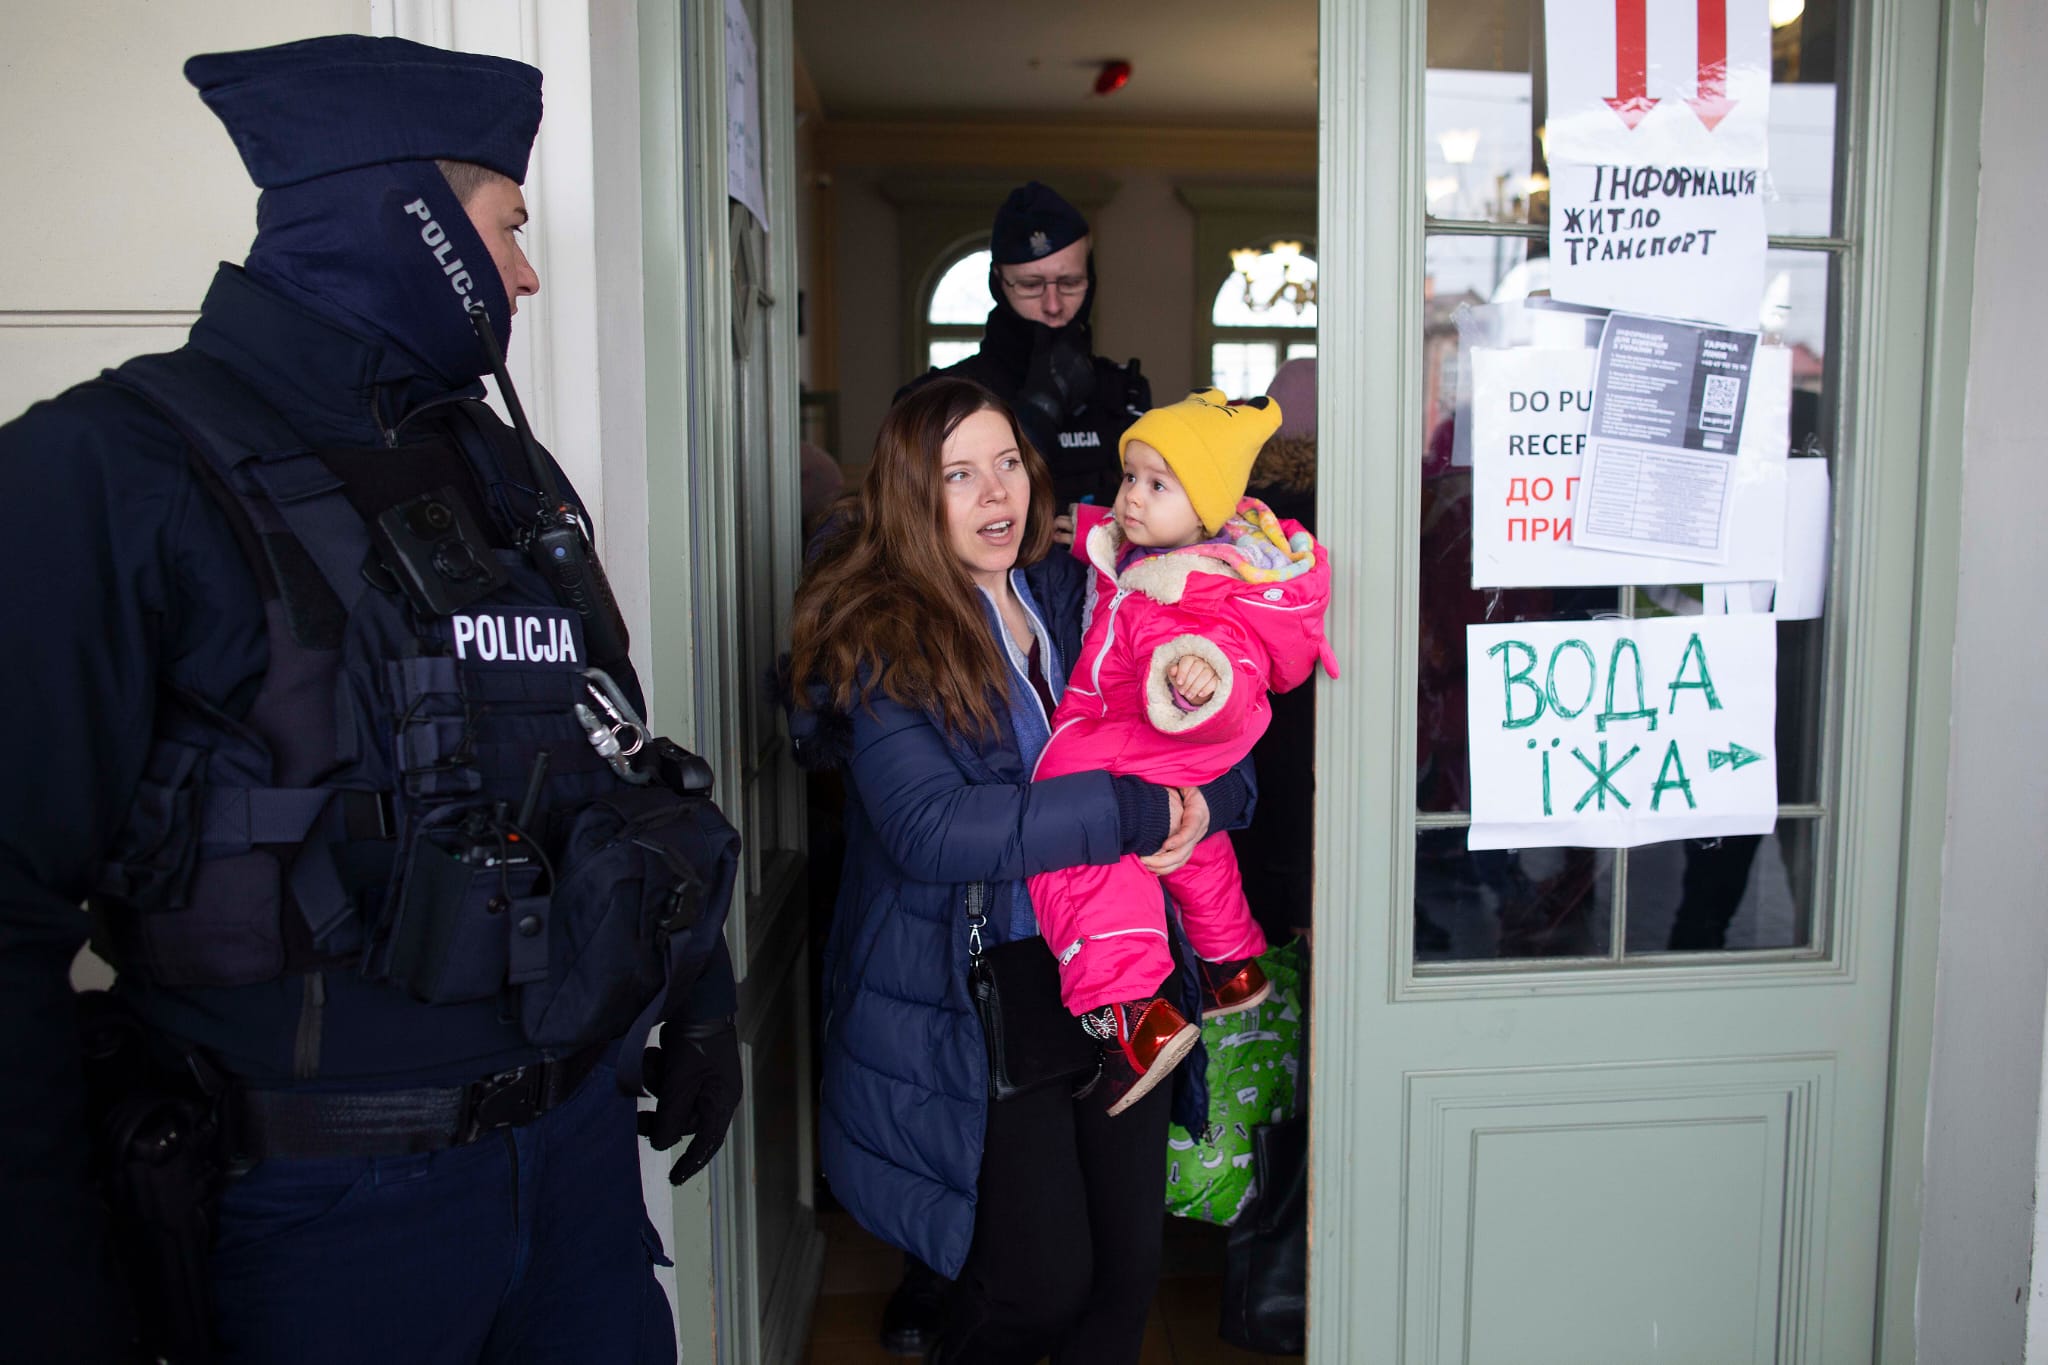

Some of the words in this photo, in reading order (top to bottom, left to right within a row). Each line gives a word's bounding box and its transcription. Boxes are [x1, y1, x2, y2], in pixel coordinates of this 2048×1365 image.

[1590, 164, 1757, 203] ІНФОРМАЦІЯ
[1563, 207, 1661, 235] ЖИТЛО
[1563, 229, 1717, 265] ТРАНСПОРТ
[403, 197, 490, 336] POLICJ
[1509, 391, 1549, 412] DO
[1058, 431, 1101, 448] OLICJA
[1506, 477, 1554, 506] ДО
[1507, 517, 1573, 542] ПРИ
[452, 614, 578, 663] POLICJA
[1486, 632, 1724, 732] ВОДА
[1527, 737, 1697, 816] ЇЖА
